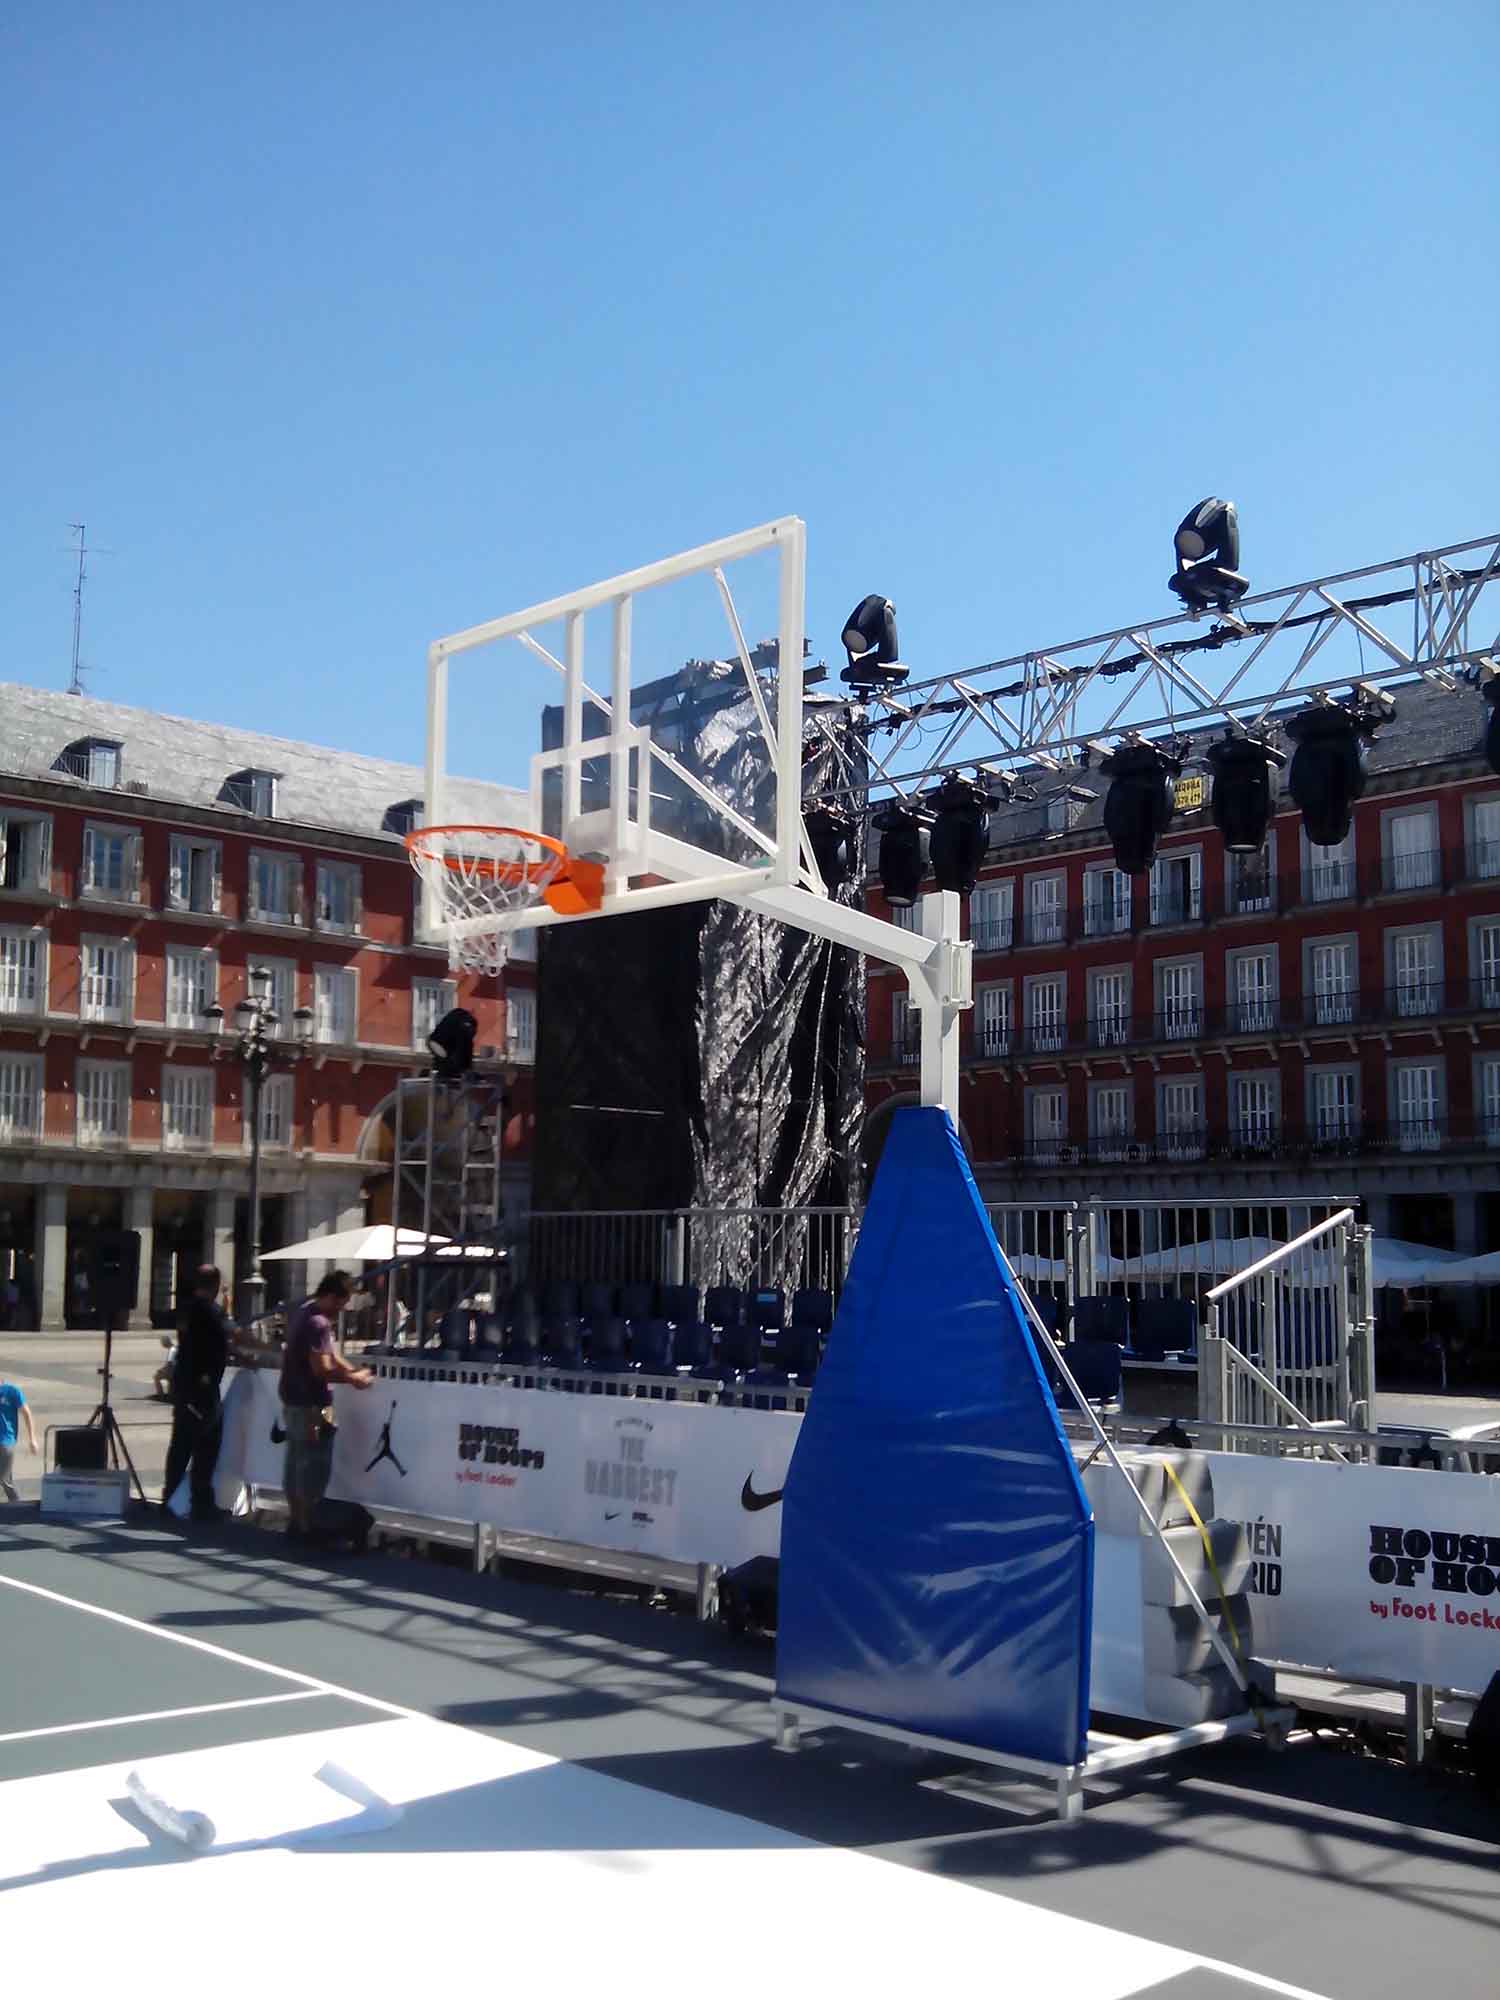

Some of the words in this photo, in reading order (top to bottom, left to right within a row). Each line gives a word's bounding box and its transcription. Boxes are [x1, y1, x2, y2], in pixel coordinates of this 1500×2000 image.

[1369, 1555, 1425, 1588] OF
[1431, 1561, 1500, 1596] HO
[1370, 1601, 1388, 1619] by
[1393, 1597, 1437, 1622] Foot
